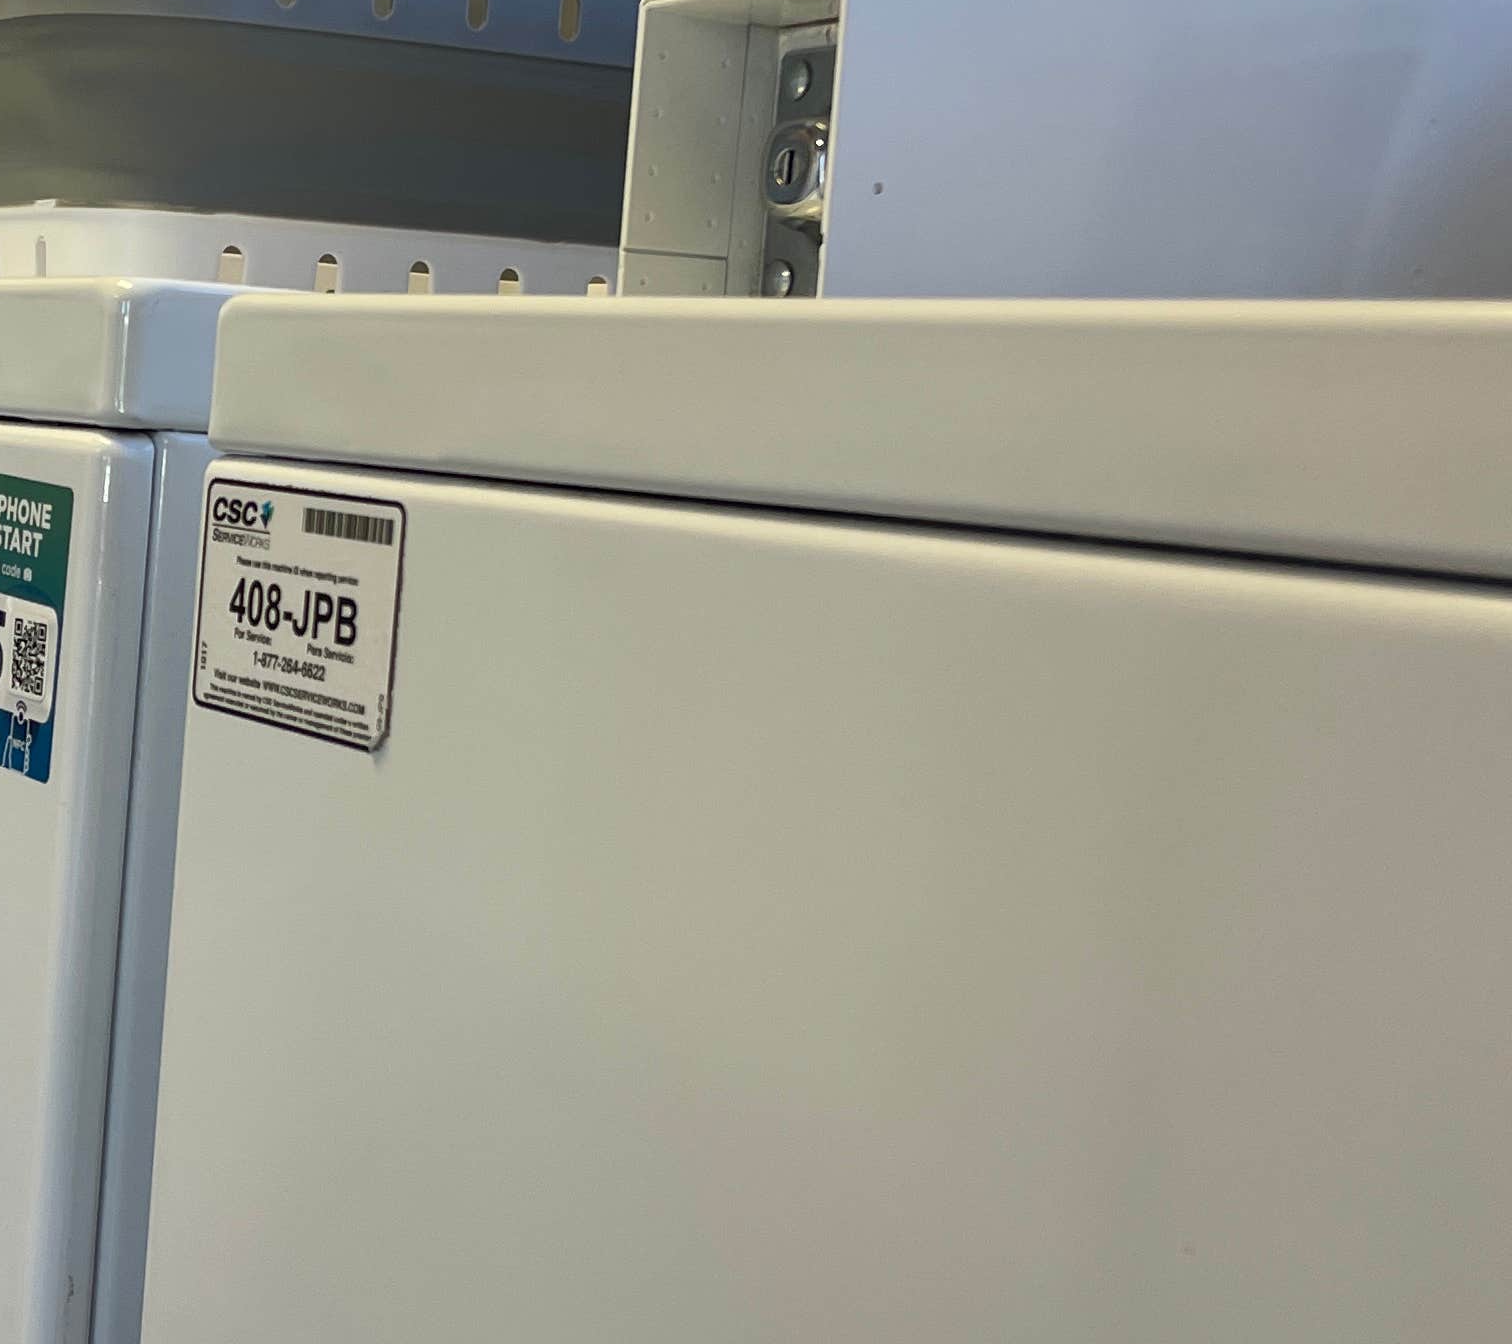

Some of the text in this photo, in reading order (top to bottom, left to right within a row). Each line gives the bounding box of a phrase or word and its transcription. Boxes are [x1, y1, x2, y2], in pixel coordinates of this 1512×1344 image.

[213, 497, 258, 527] CSC
[2, 563, 21, 579] code
[229, 577, 357, 647] 408-JPB
[253, 650, 325, 682] 1-877-264-6622
